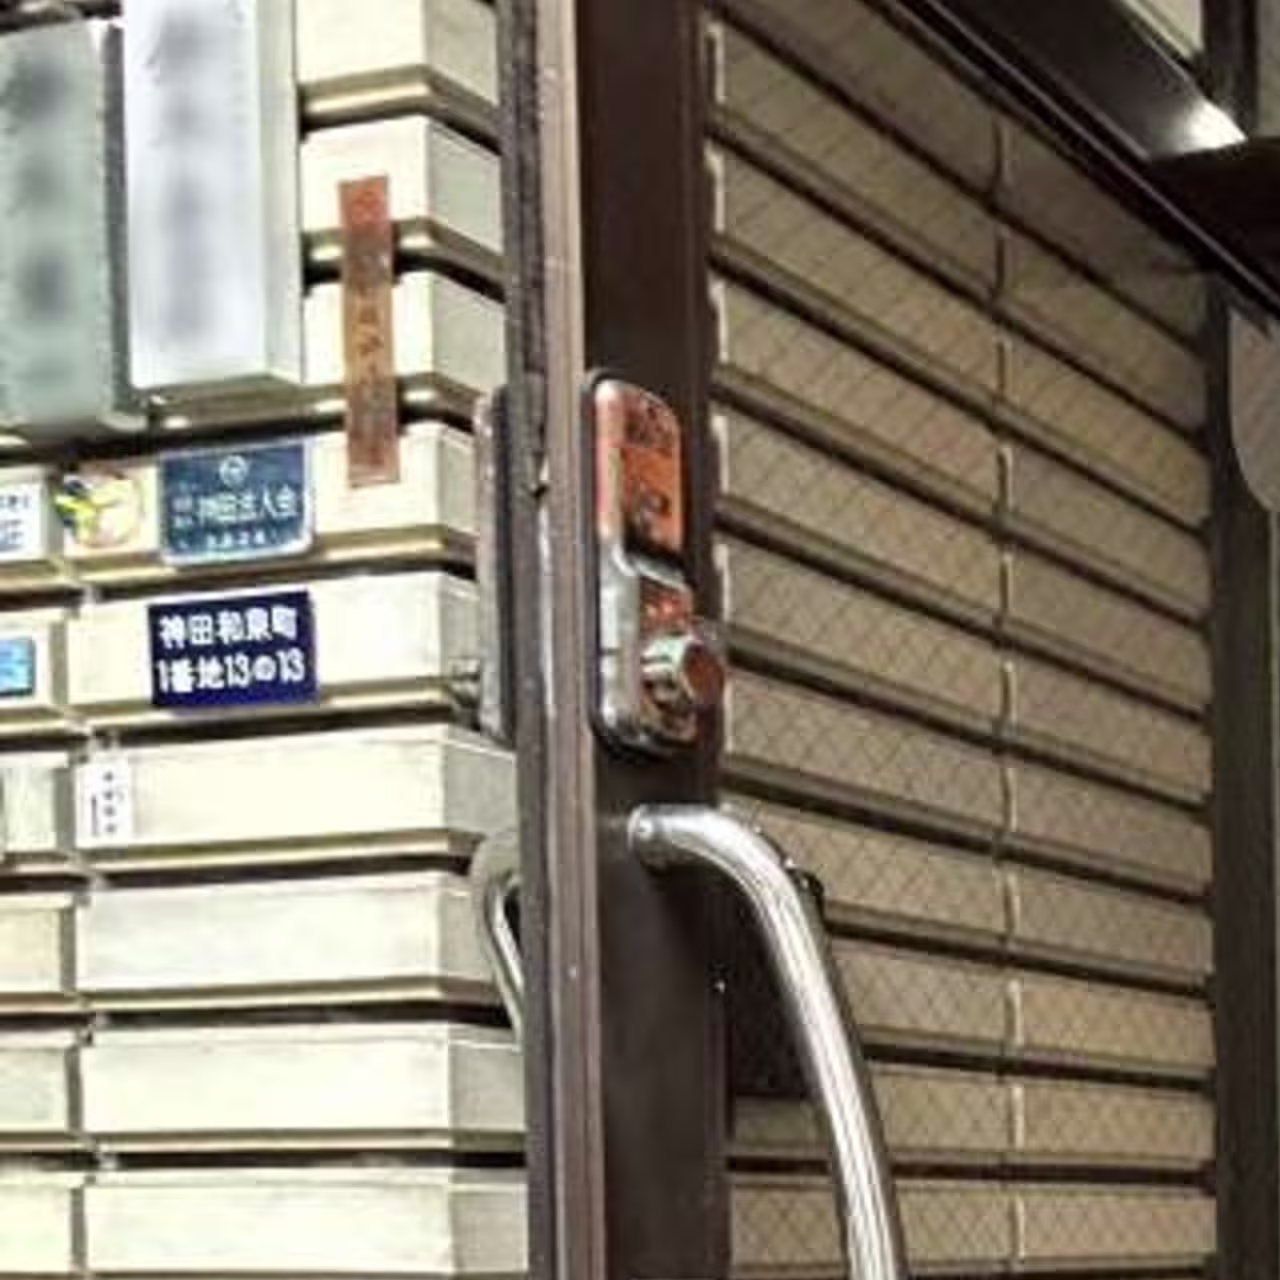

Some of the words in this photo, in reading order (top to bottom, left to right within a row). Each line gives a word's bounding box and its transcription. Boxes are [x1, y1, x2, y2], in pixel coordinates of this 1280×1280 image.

[159, 605, 298, 649] 神田和泉町
[157, 647, 305, 693] 1番地13の13
